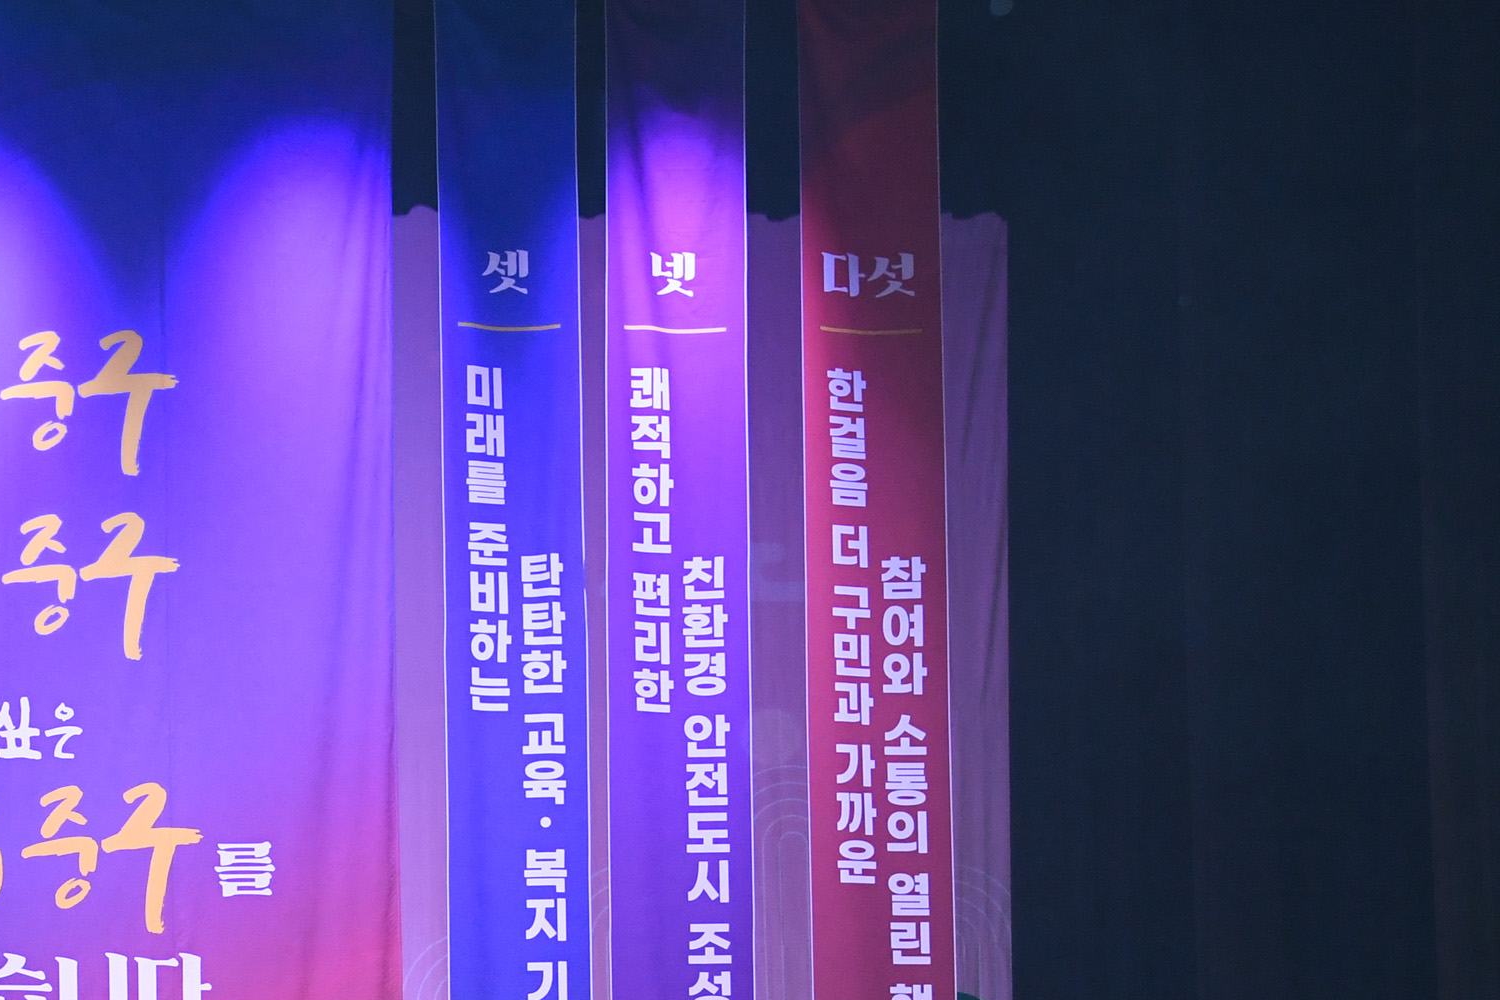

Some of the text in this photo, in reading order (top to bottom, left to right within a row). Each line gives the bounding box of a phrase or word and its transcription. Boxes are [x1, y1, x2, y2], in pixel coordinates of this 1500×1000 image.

[481, 249, 529, 295] 셋
[650, 251, 696, 298] 넷
[820, 251, 916, 298] 다섯
[0, 330, 180, 477] 중구
[1, 511, 181, 661] 중구
[465, 364, 513, 712] 미래를 준비하는
[629, 366, 675, 714] 쾌적하고 편리한
[520, 552, 567, 694] 탄탄한
[682, 555, 729, 697] 친환경
[826, 367, 877, 885] 한걸음 더 구민과 가까운
[881, 556, 928, 696] 참여와
[683, 714, 731, 904] 안전도시
[883, 714, 928, 854] 소통의
[887, 872, 932, 965] 열린
